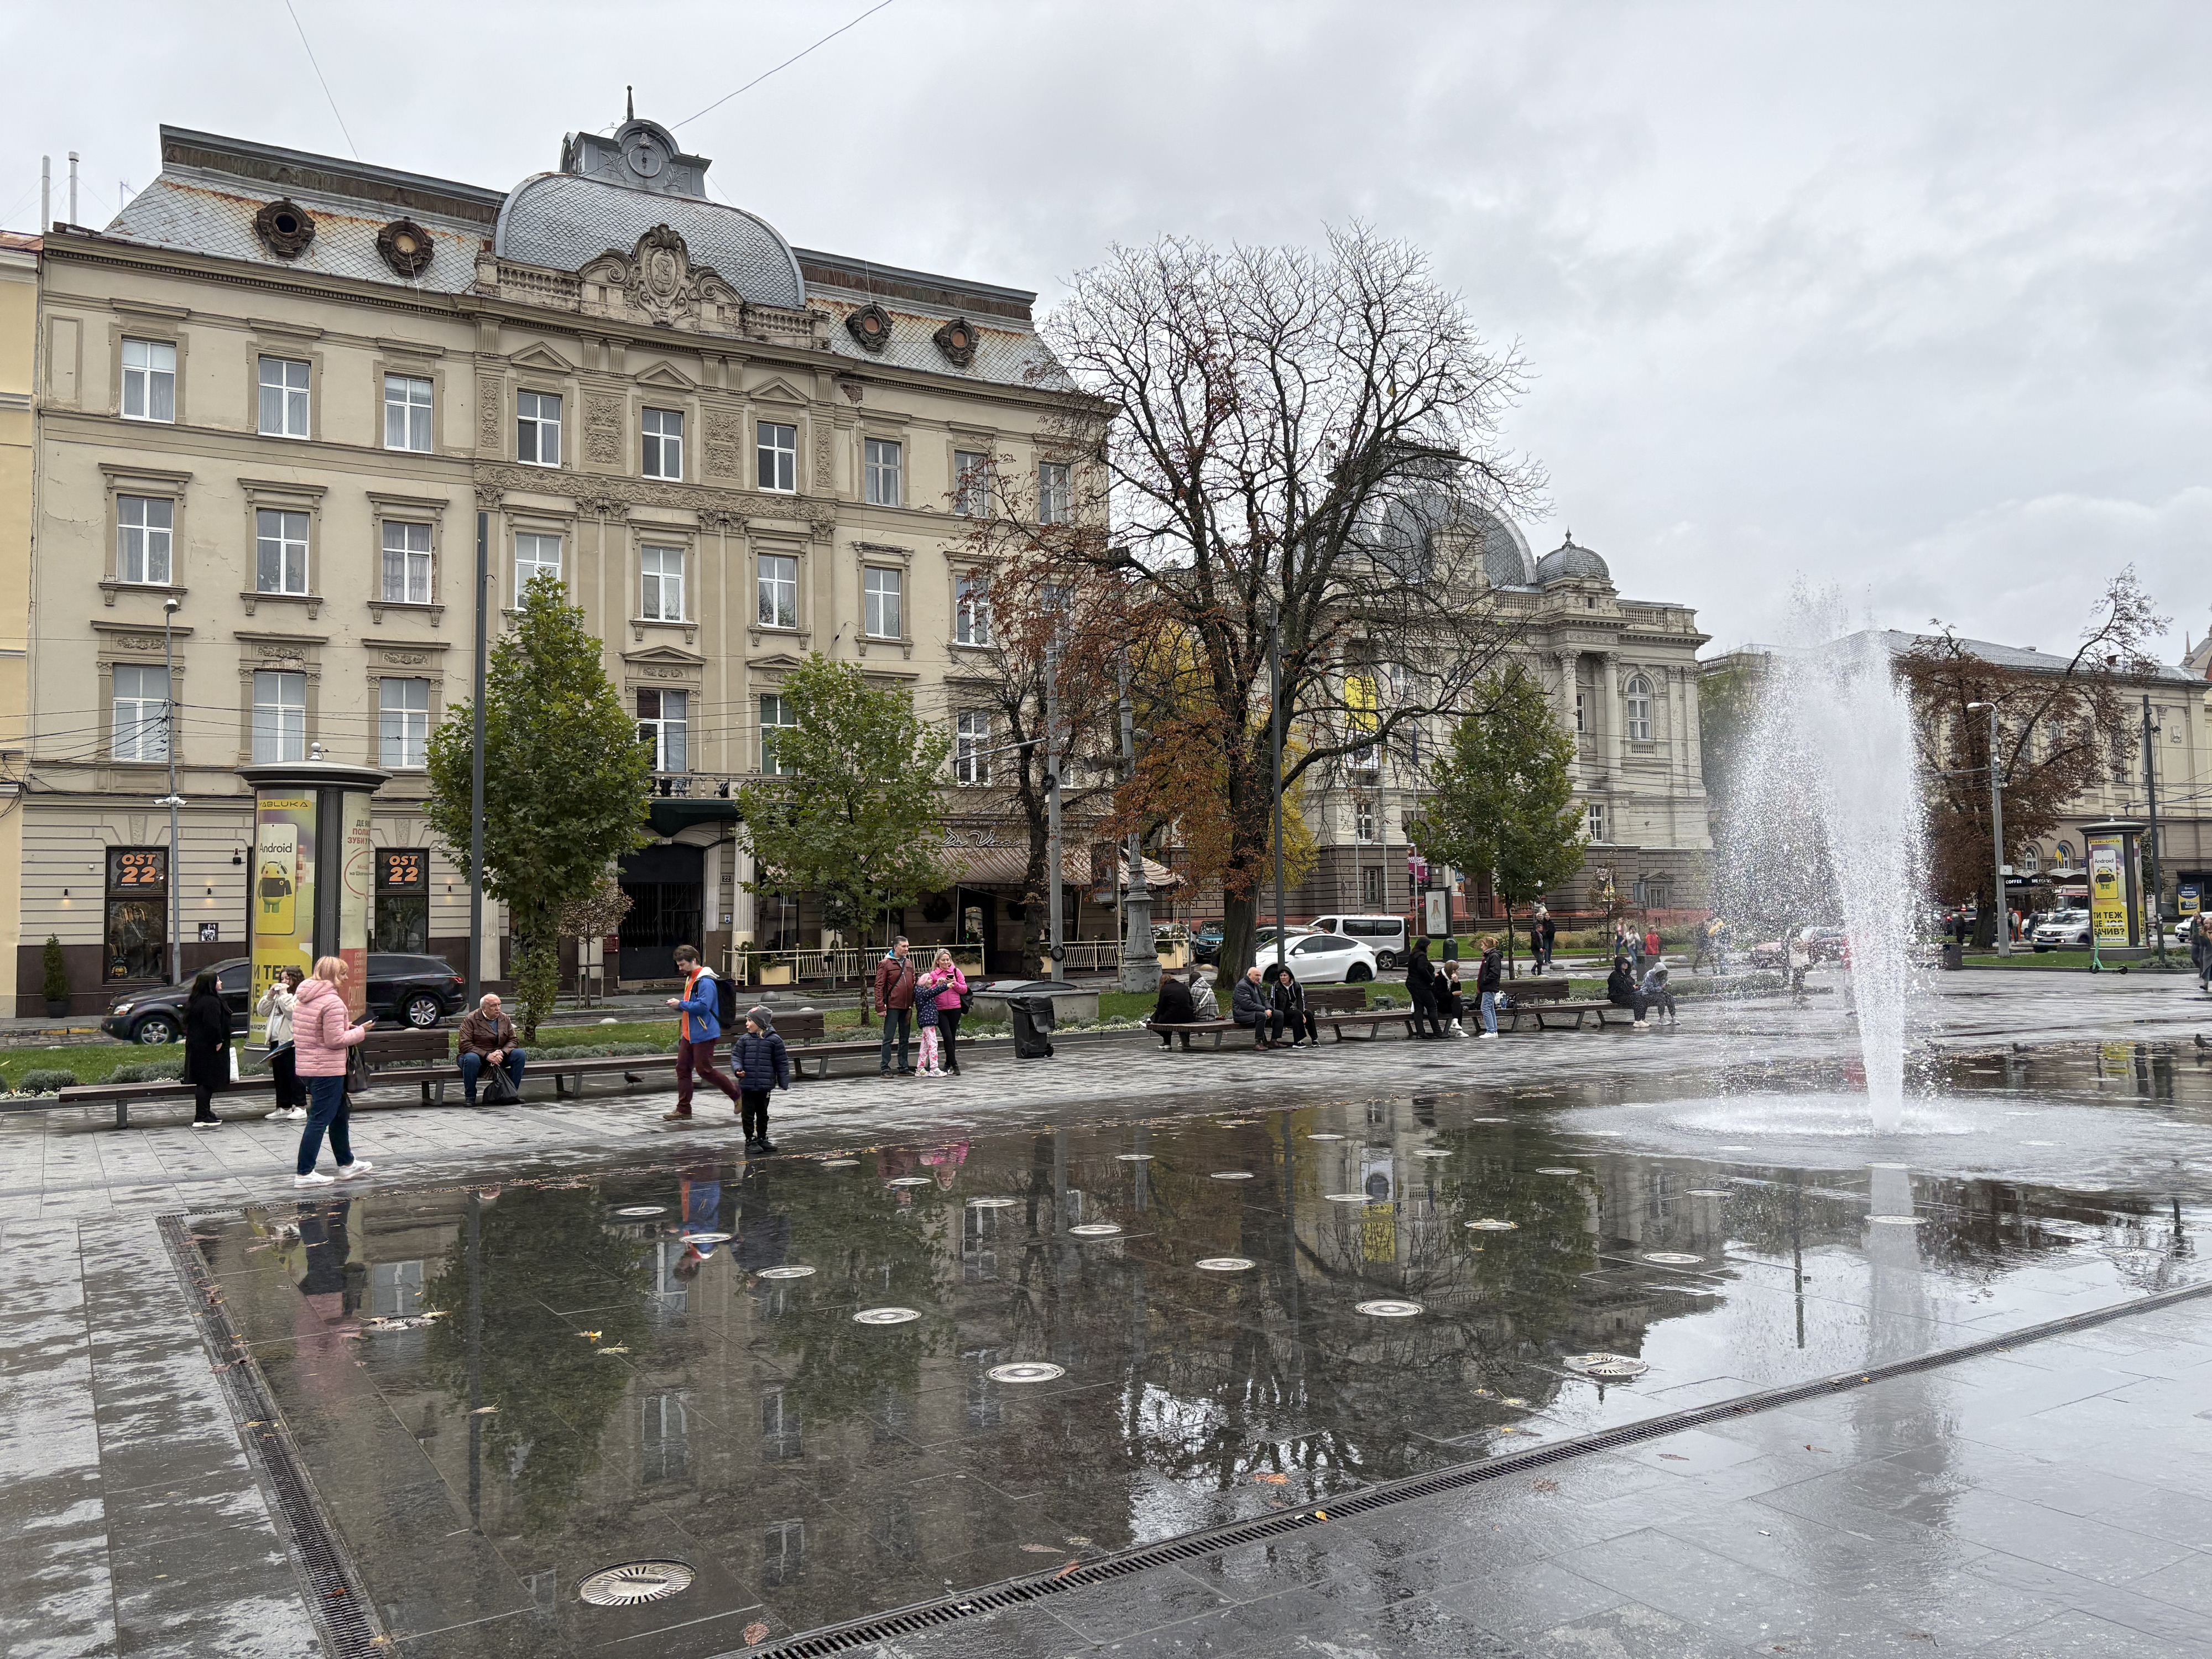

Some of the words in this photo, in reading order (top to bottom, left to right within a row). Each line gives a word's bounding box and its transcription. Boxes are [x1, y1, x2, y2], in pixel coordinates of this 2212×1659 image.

[934, 828, 968, 847] Da
[259, 843, 292, 853] Android
[122, 854, 156, 865] OST
[389, 855, 418, 865] OST
[122, 867, 156, 882] 22
[389, 867, 418, 881] 22
